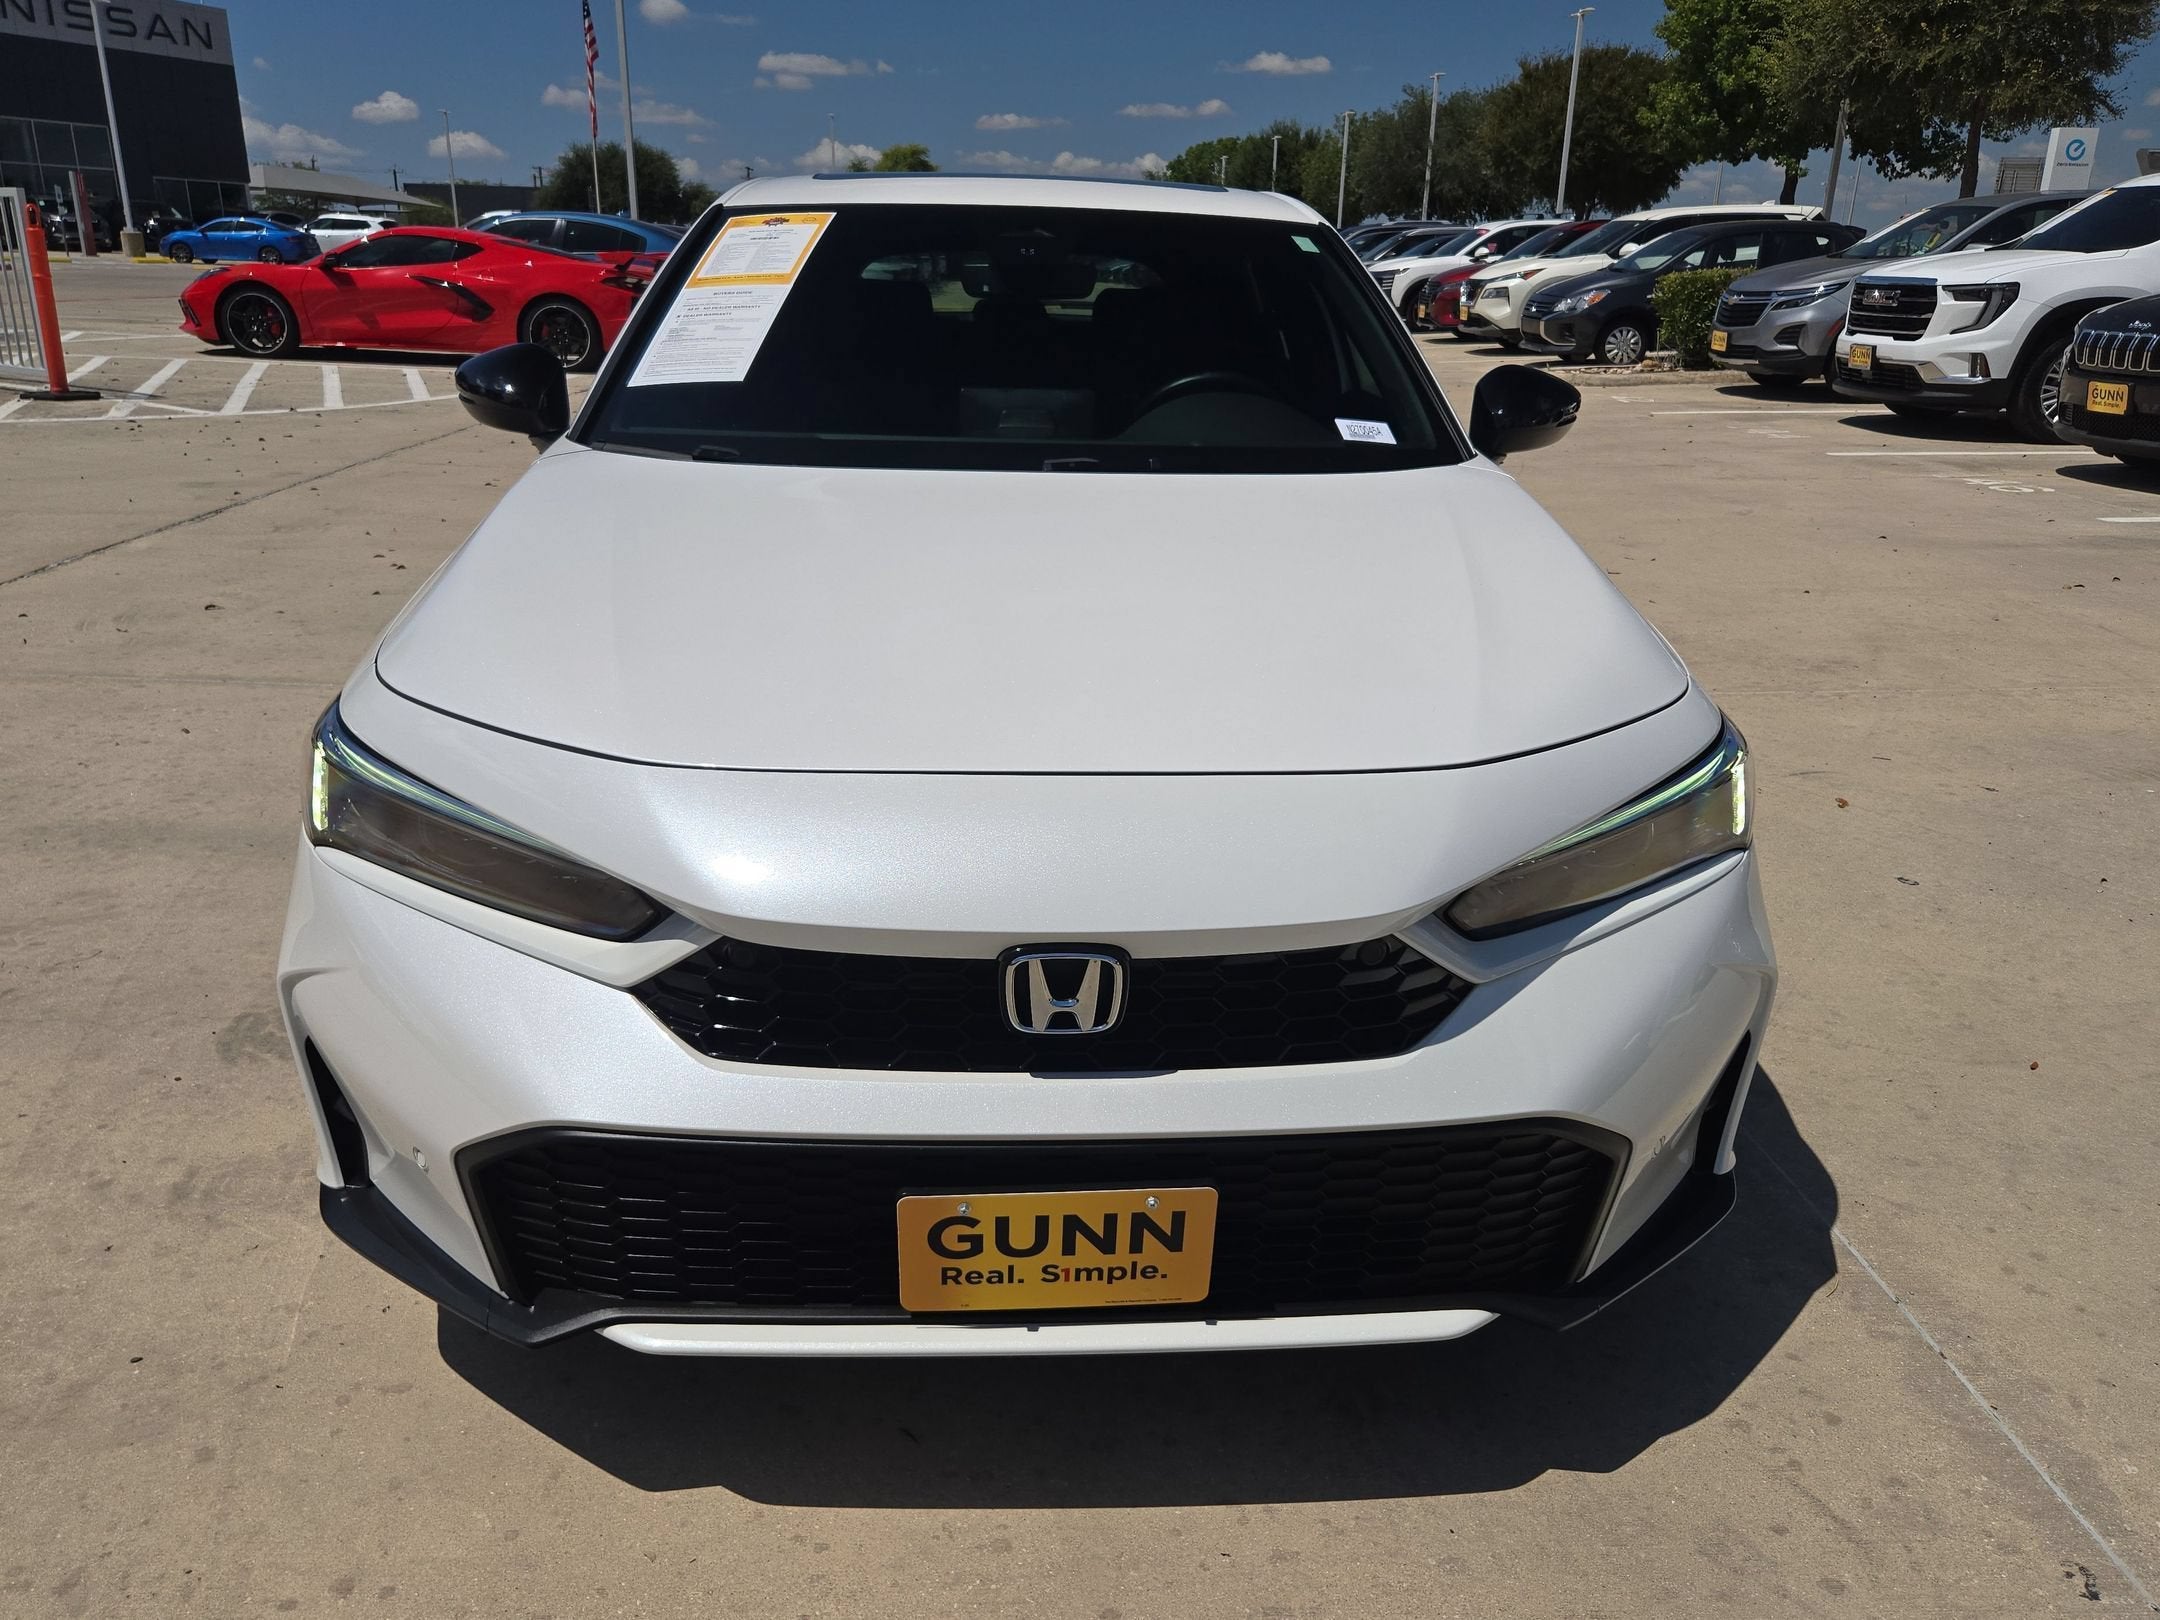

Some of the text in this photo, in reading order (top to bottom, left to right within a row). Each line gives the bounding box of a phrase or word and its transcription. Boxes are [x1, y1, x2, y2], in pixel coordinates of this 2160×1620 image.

[2, 0, 213, 50] NISSAN
[2091, 388, 2124, 402] GUNN
[927, 1210, 1187, 1260] GUNN
[941, 1265, 1025, 1286] Real.
